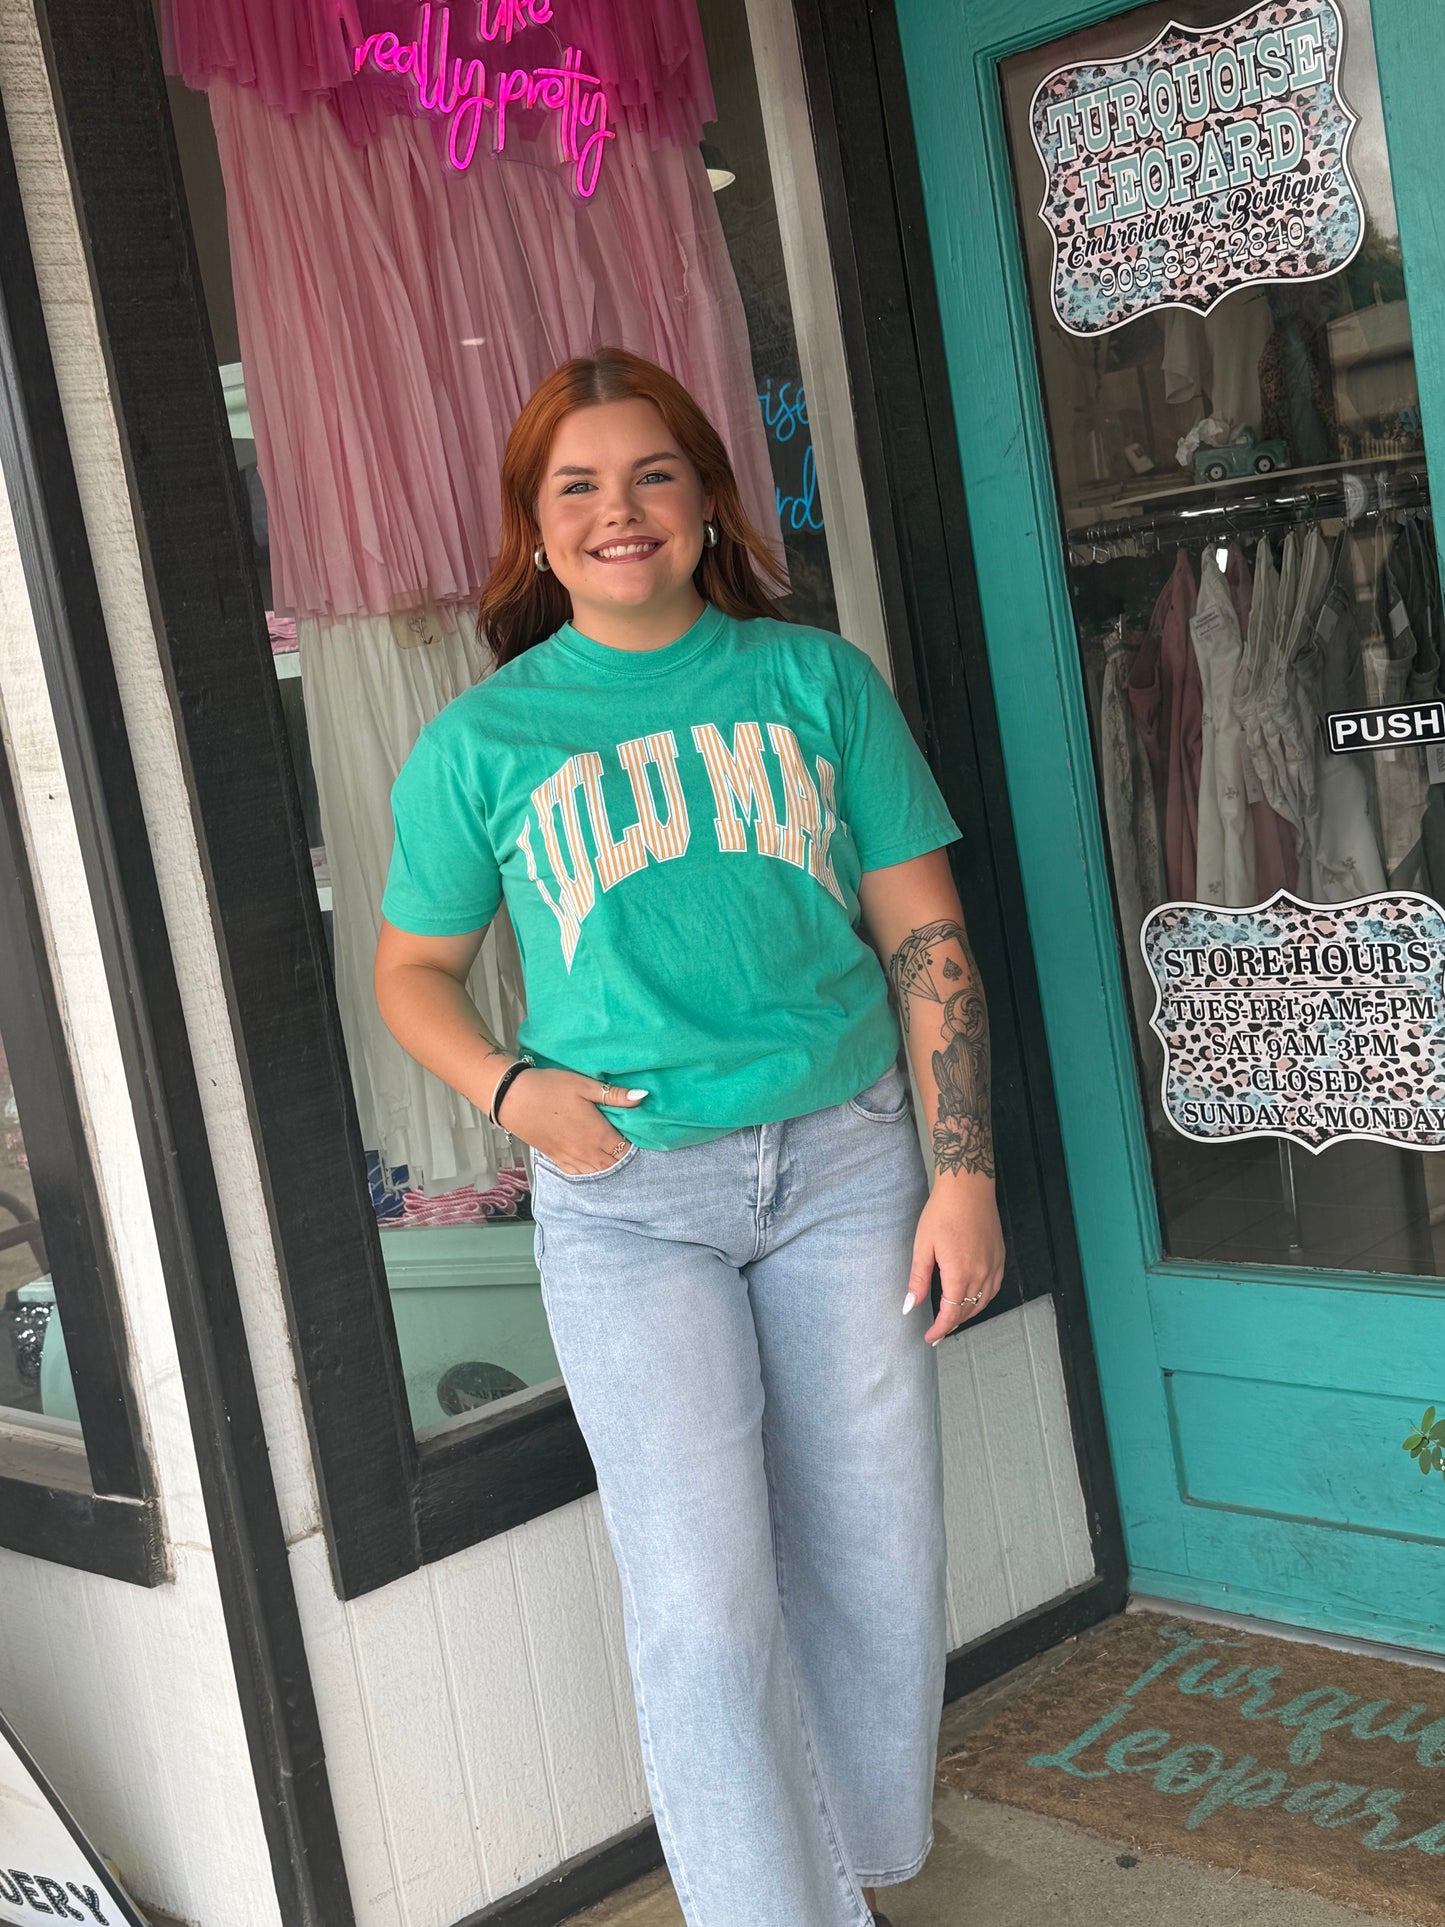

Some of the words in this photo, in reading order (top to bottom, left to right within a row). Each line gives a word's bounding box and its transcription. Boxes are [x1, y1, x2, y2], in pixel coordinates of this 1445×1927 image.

[354, 3, 494, 170] really
[497, 47, 616, 198] pretty
[1046, 17, 1328, 164] TURQUOISE
[1079, 108, 1304, 230] LEOPARD
[1067, 211, 1194, 270] Embroidery
[1200, 199, 1223, 231] &
[1226, 171, 1335, 223] Boutique
[1099, 216, 1305, 297] 903-852-2840
[1335, 709, 1440, 745] PUSH
[1163, 946, 1283, 979] STORE
[1292, 941, 1432, 976] HOURS
[1171, 998, 1297, 1022] TUES-FRI
[1300, 996, 1436, 1025] 9AM-5PM
[1211, 1034, 1260, 1057] SAT
[1266, 1033, 1399, 1061] 9AM-3PM
[1252, 1070, 1363, 1093] CLOSED
[1183, 1102, 1290, 1127] SUNDAY
[1296, 1106, 1318, 1127] &
[1324, 1106, 1445, 1131] MONDAY
[1027, 1703, 1445, 1855] Leopar
